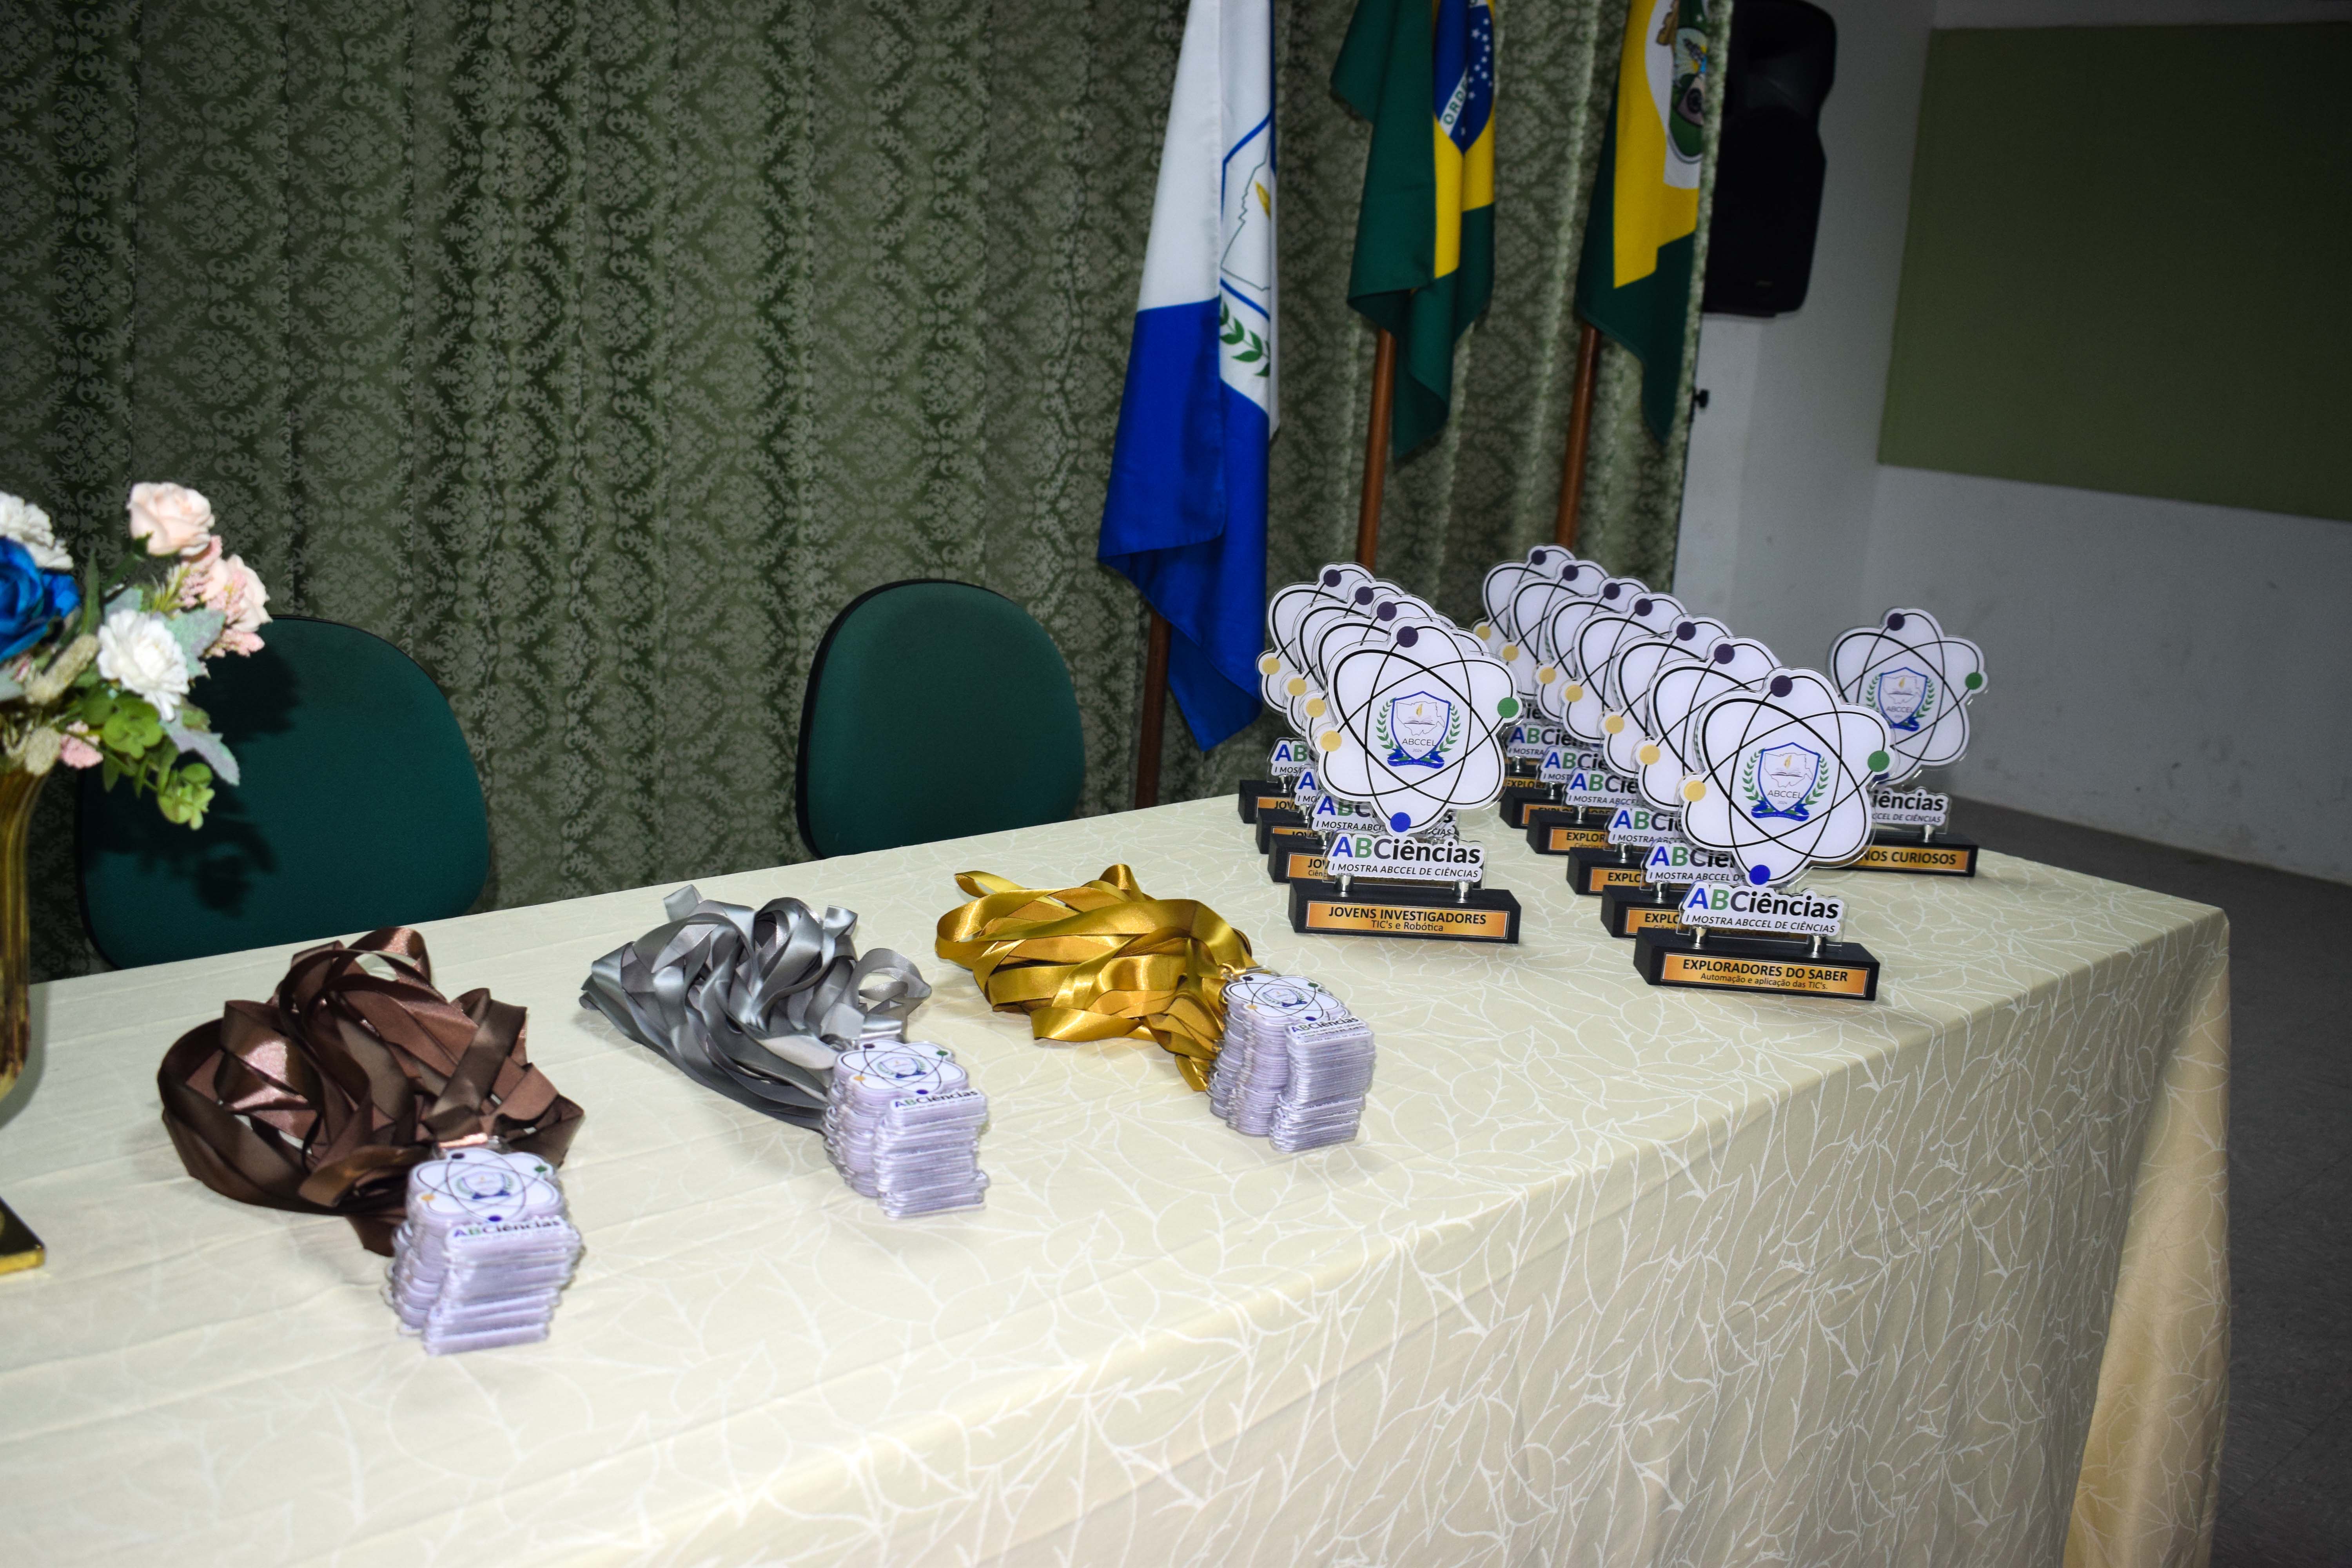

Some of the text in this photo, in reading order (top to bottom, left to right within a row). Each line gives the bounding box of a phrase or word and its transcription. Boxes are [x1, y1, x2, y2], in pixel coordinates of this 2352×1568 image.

[1402, 738, 1437, 746] ABCCEL
[1767, 790, 1803, 799] ABCCEL
[1868, 789, 1944, 811] iências
[1905, 814, 1941, 823] CIÊNCIAS
[1321, 821, 1358, 830] MOSTRA
[1566, 832, 1606, 842] EXPLOR
[1618, 834, 1654, 843] MOSTRA
[1332, 837, 1481, 864] ABCiências
[1308, 858, 1330, 869] JOV
[1860, 851, 1957, 865] NOS CURIOSOS
[1338, 864, 1378, 873] MOSTRA
[1380, 866, 1416, 875] ABCCEL
[1435, 867, 1479, 878] CIÊNCIAS
[1608, 872, 1643, 882] EXPLO
[1687, 887, 1839, 919] ABCiências
[1329, 907, 1486, 924] JOVENS INVESTIGADORES
[1645, 913, 1680, 924] EXPLO
[1371, 920, 1392, 929] TIC's
[1403, 921, 1444, 932] Robótica
[1692, 915, 1732, 925] MOSTRA
[1735, 918, 1771, 927] ABCCEL
[1791, 921, 1835, 933] CIÊNCIAS
[1682, 959, 1848, 982] EXPLORADORES DO SABER
[1700, 973, 1746, 984] Automação
[1754, 976, 1791, 988] aplicação
[1793, 979, 1806, 988] das
[1808, 981, 1828, 990] TIC's.
[1291, 1017, 1359, 1033] ABCiências
